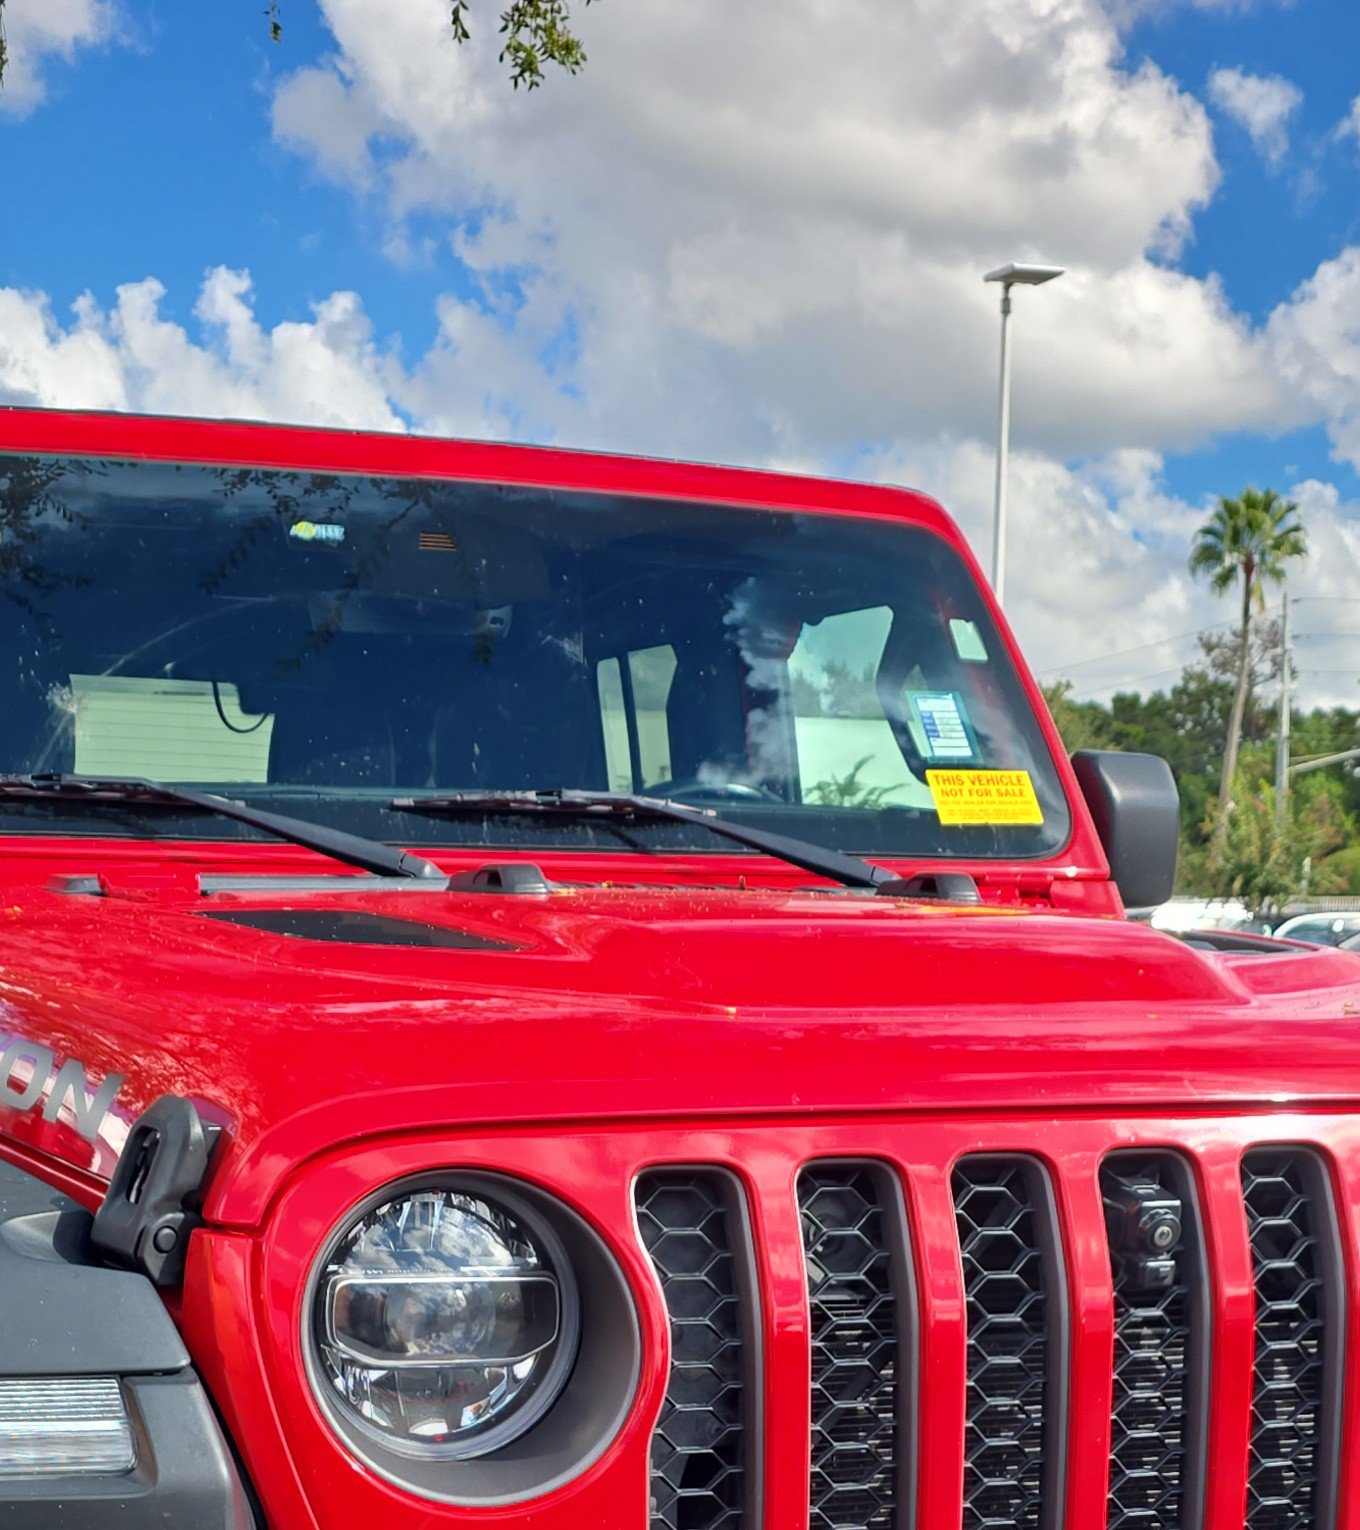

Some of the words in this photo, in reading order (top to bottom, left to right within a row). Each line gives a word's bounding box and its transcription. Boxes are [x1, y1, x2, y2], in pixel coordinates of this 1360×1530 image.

[933, 774, 965, 786] THIS
[967, 774, 1025, 786] VEHICLE
[941, 788, 964, 797] NOT
[968, 788, 992, 797] FOR
[996, 788, 1026, 797] SALE
